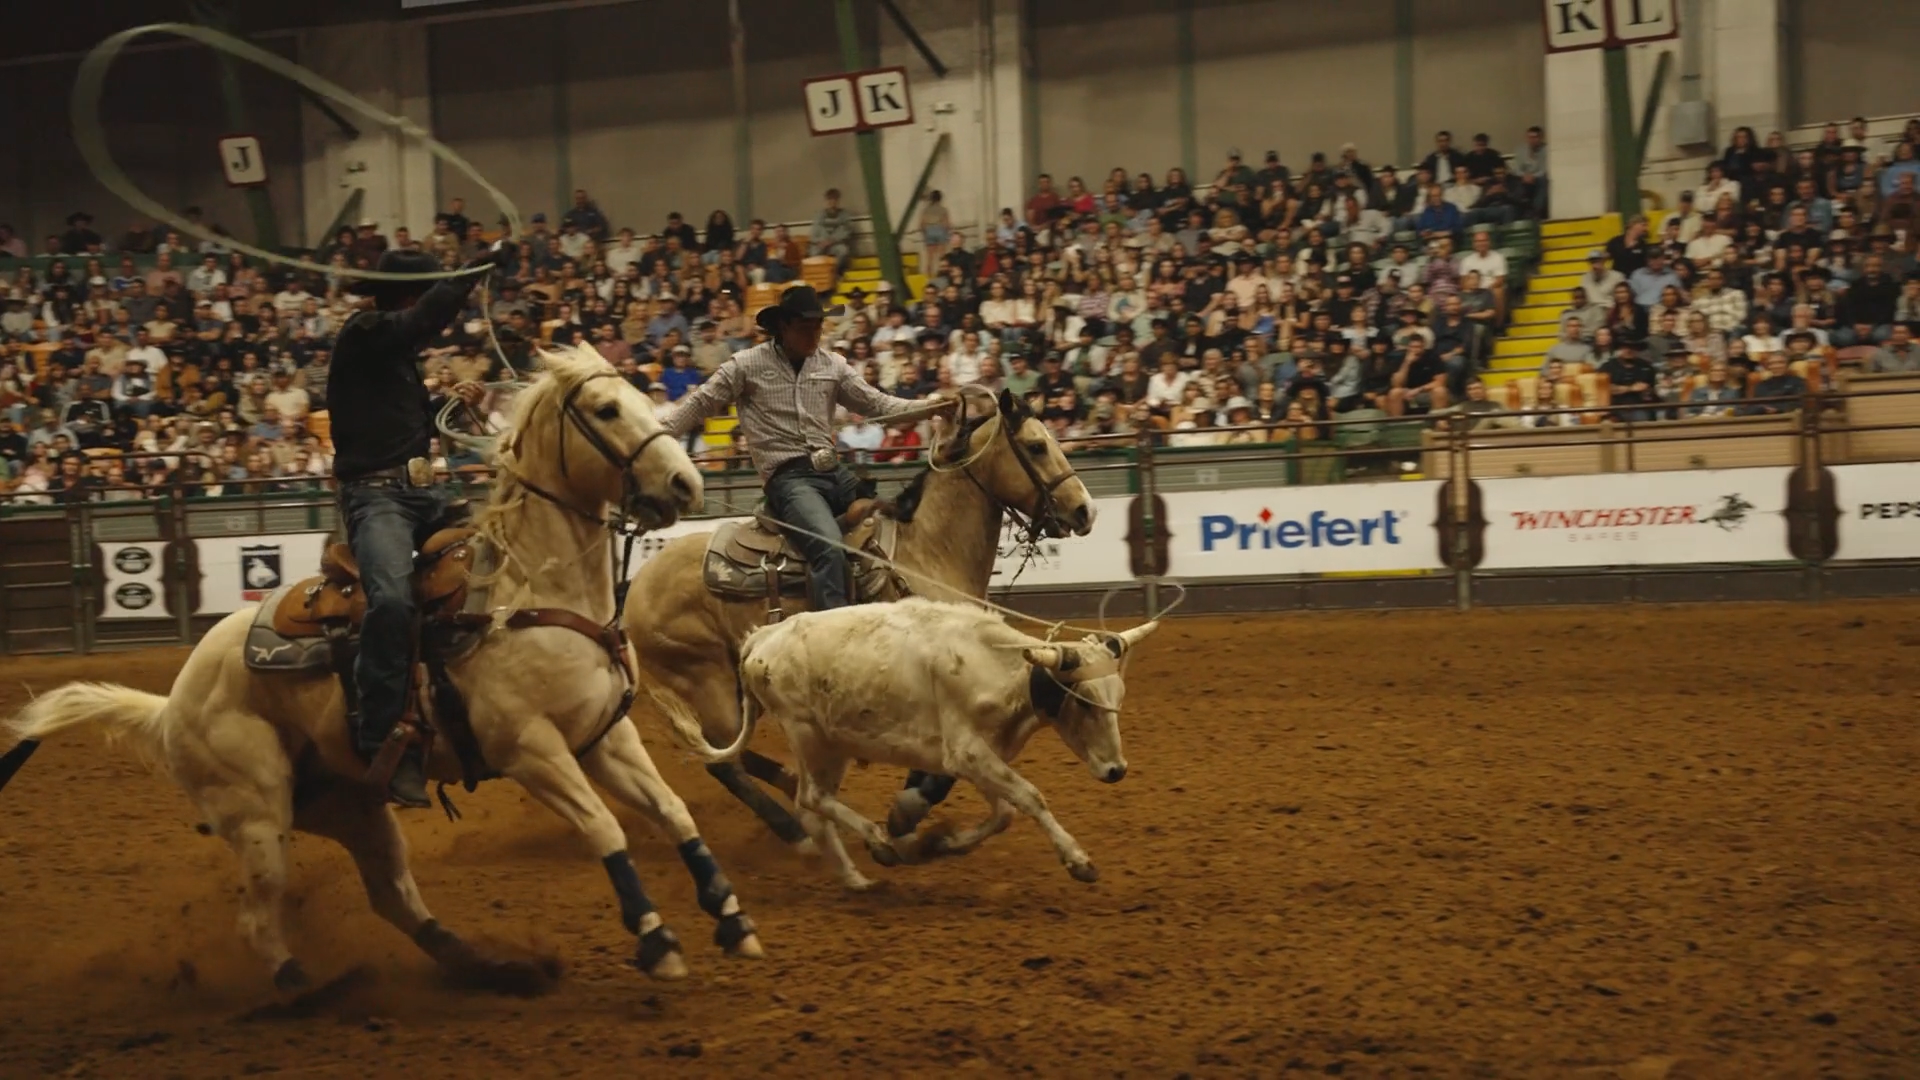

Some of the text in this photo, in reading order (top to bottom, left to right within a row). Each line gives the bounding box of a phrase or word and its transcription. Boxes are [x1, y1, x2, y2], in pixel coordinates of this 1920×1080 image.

[1553, 0, 1664, 34] K L
[819, 82, 903, 118] J K
[231, 146, 251, 172] J
[1201, 508, 1400, 551] Priefert
[1510, 504, 1698, 530] WINCHESTER
